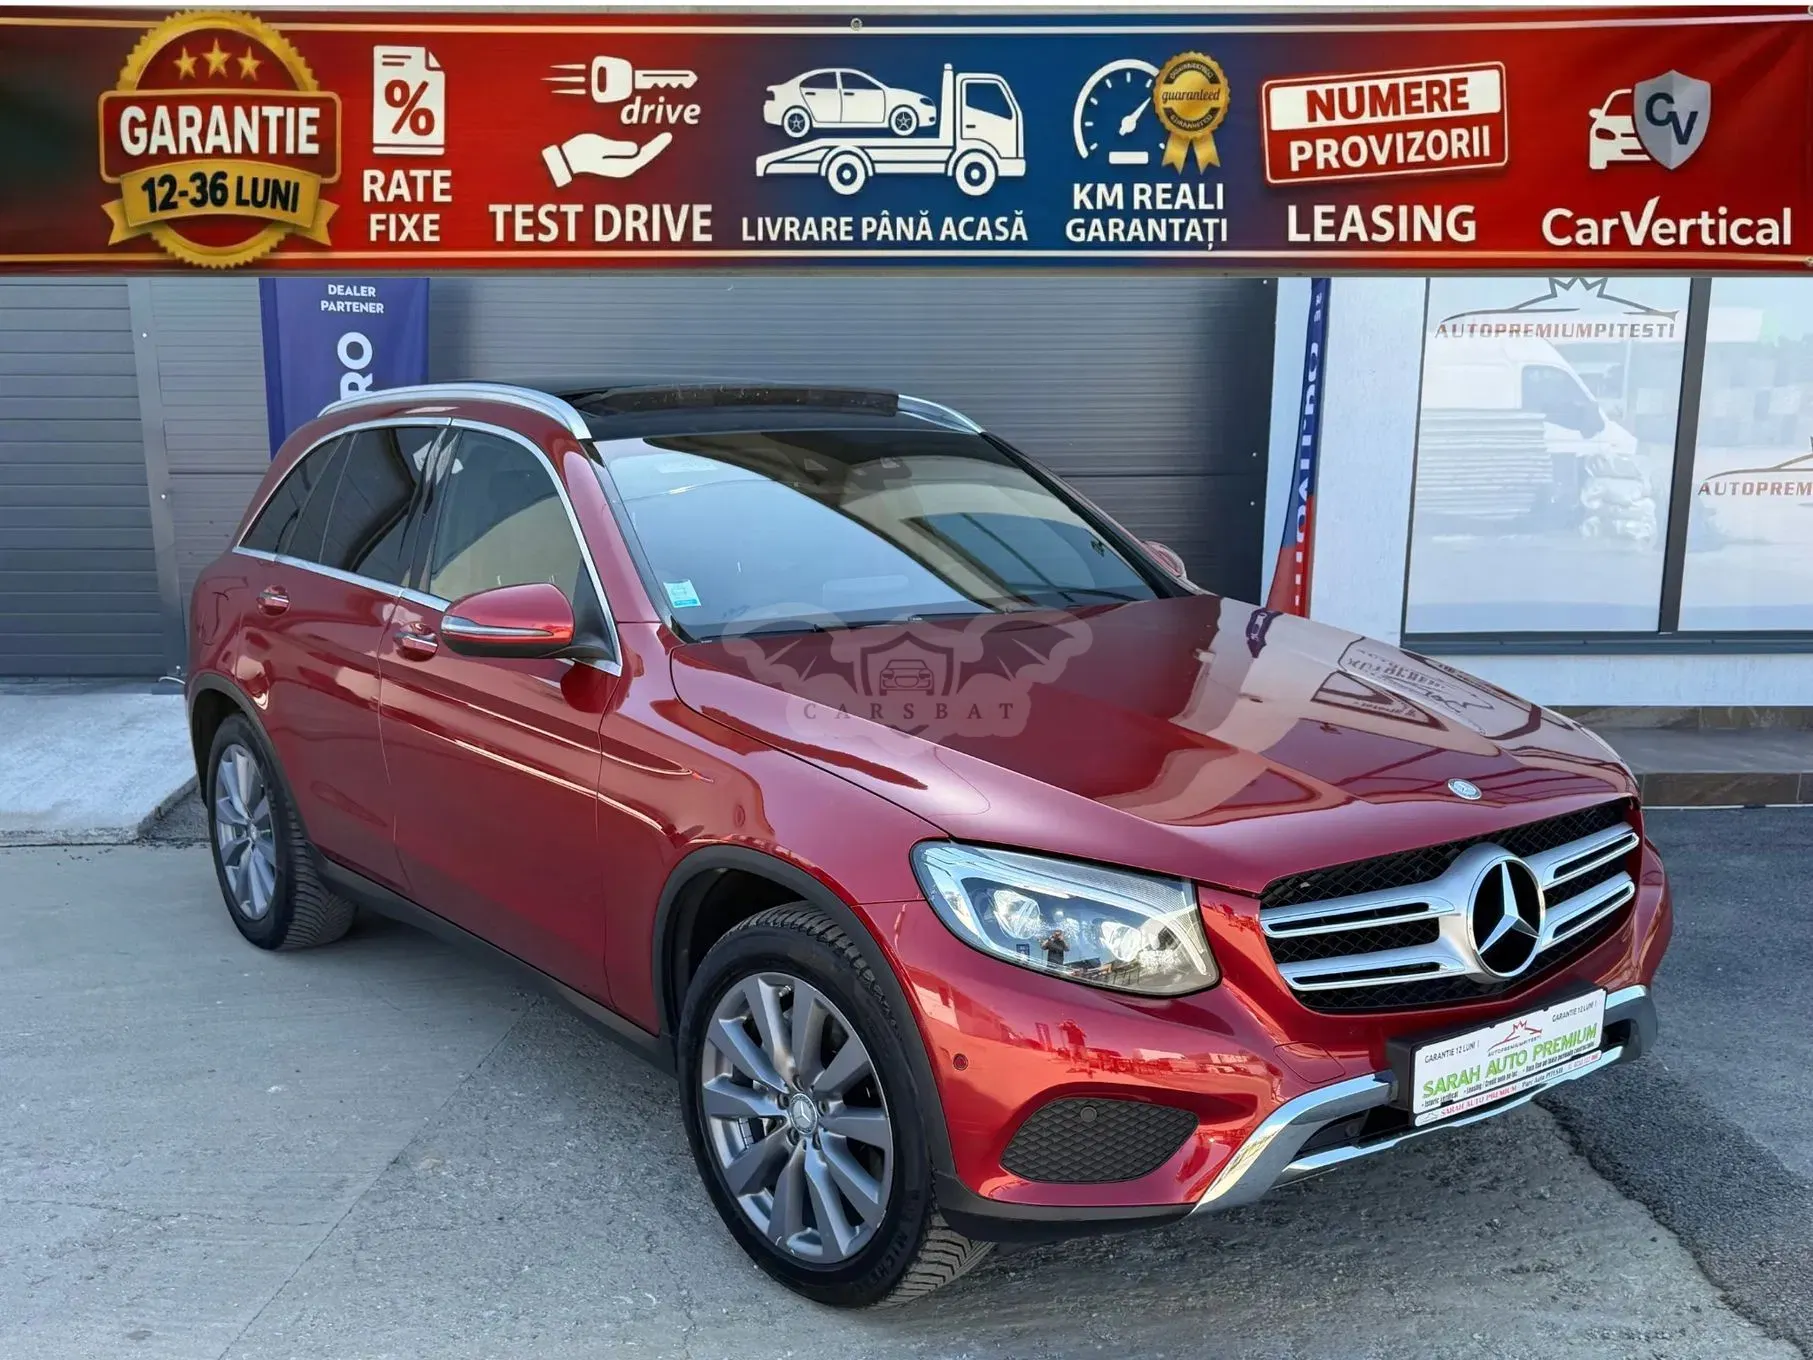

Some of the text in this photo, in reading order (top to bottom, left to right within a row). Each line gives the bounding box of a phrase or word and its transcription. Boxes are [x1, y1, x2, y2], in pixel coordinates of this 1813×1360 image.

[620, 95, 701, 125] drive
[1162, 88, 1220, 104] guaranteed
[1306, 77, 1470, 123] NUMERE
[119, 105, 320, 156] GARANTIE
[1289, 125, 1491, 172] PROVIZORII
[142, 171, 299, 213] 12-36 LUNI
[363, 169, 452, 202] RATE
[1072, 183, 1224, 210] KM REALI
[370, 214, 440, 242] FIXE
[489, 204, 713, 242] TEST DRIVE
[742, 209, 1028, 242] LIVRARE PÂNĂ ACASĂ
[1065, 218, 1228, 251] GARANTAȚI
[1287, 204, 1477, 243] LEASING
[1541, 196, 1792, 246] CarVertical
[320, 300, 384, 314] PARTENER
[328, 284, 376, 297] DEALER
[1434, 322, 1675, 340] AUTOPREMIUMPITESTI
[1422, 1064, 1480, 1098] SARAH
[1485, 1049, 1527, 1079] AUTO
[1532, 1023, 1597, 1061] PREMIUM
